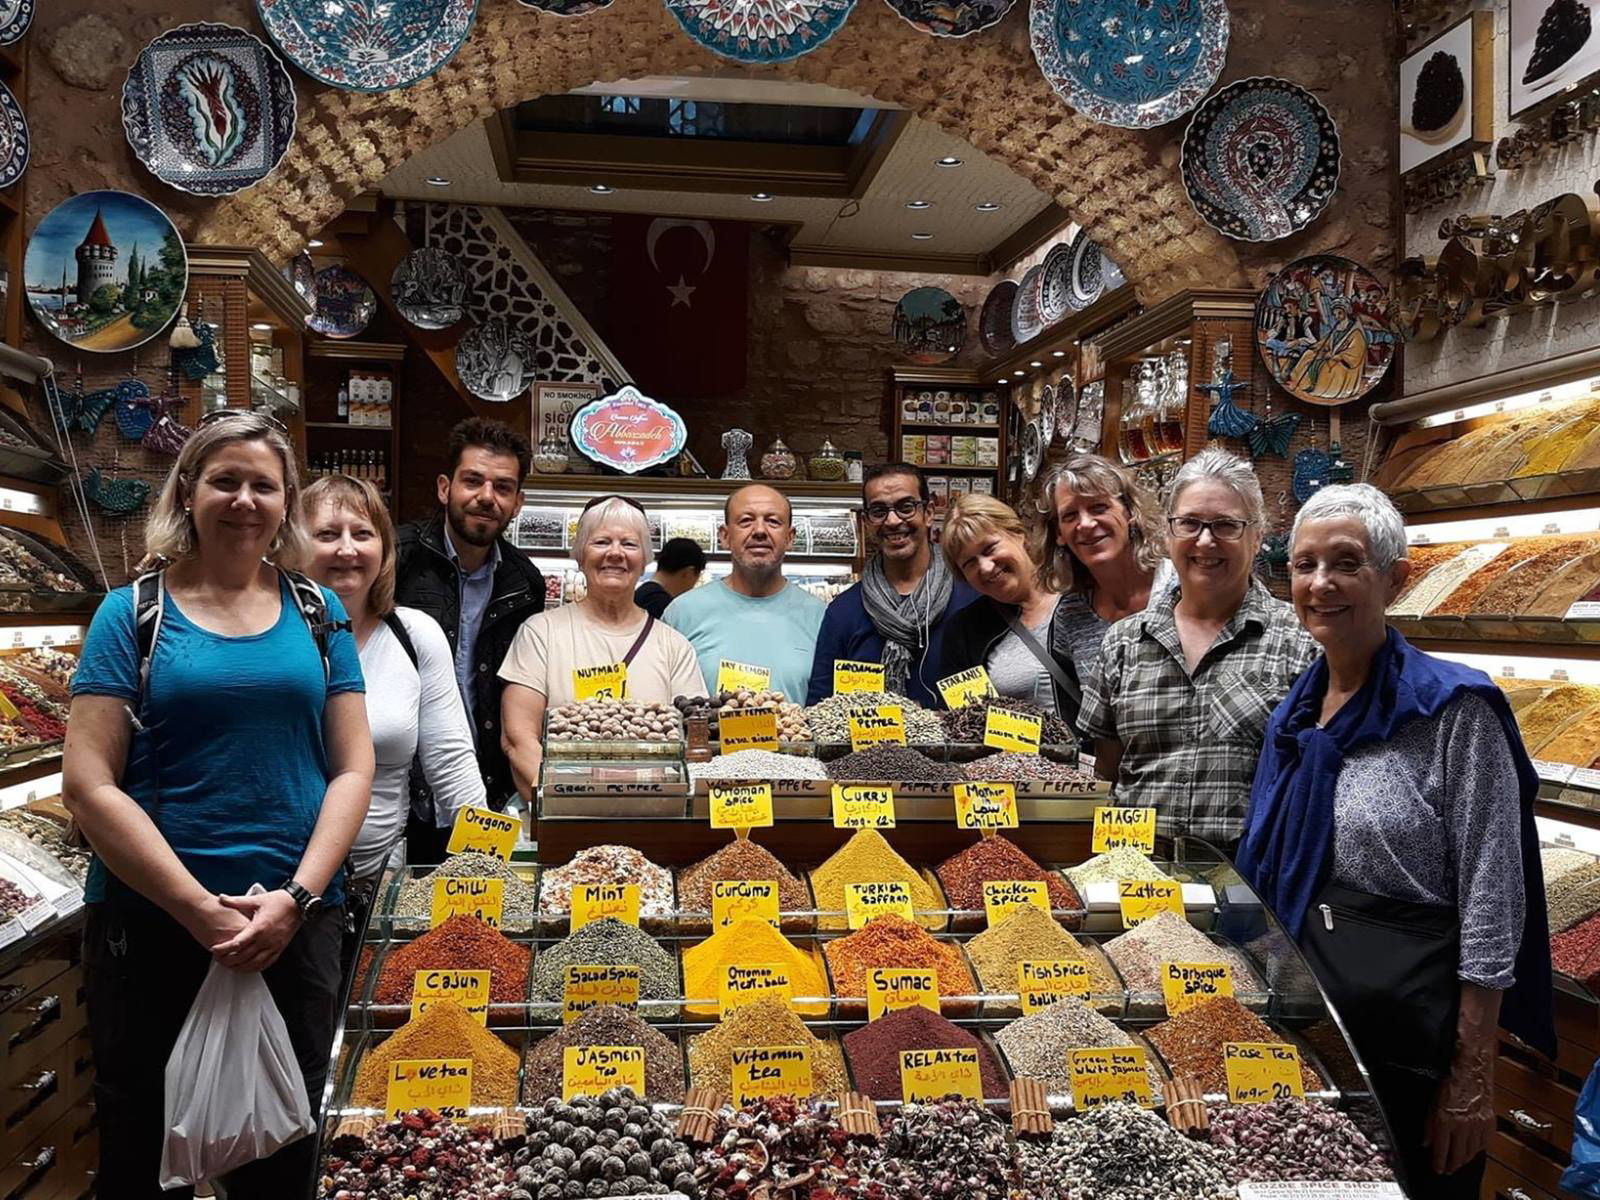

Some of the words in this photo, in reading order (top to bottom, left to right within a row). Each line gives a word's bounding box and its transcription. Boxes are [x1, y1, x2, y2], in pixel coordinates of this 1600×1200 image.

[1101, 809, 1148, 826] MAGGI
[426, 972, 478, 990] Cajun
[873, 970, 932, 991] Sumac
[733, 1049, 804, 1066] Vitamin
[1112, 1053, 1135, 1064] tea
[1266, 1047, 1295, 1061] Tea
[748, 1064, 781, 1081] tea
[1272, 1082, 1291, 1100] 20
[1344, 1182, 1380, 1190] SHOP
